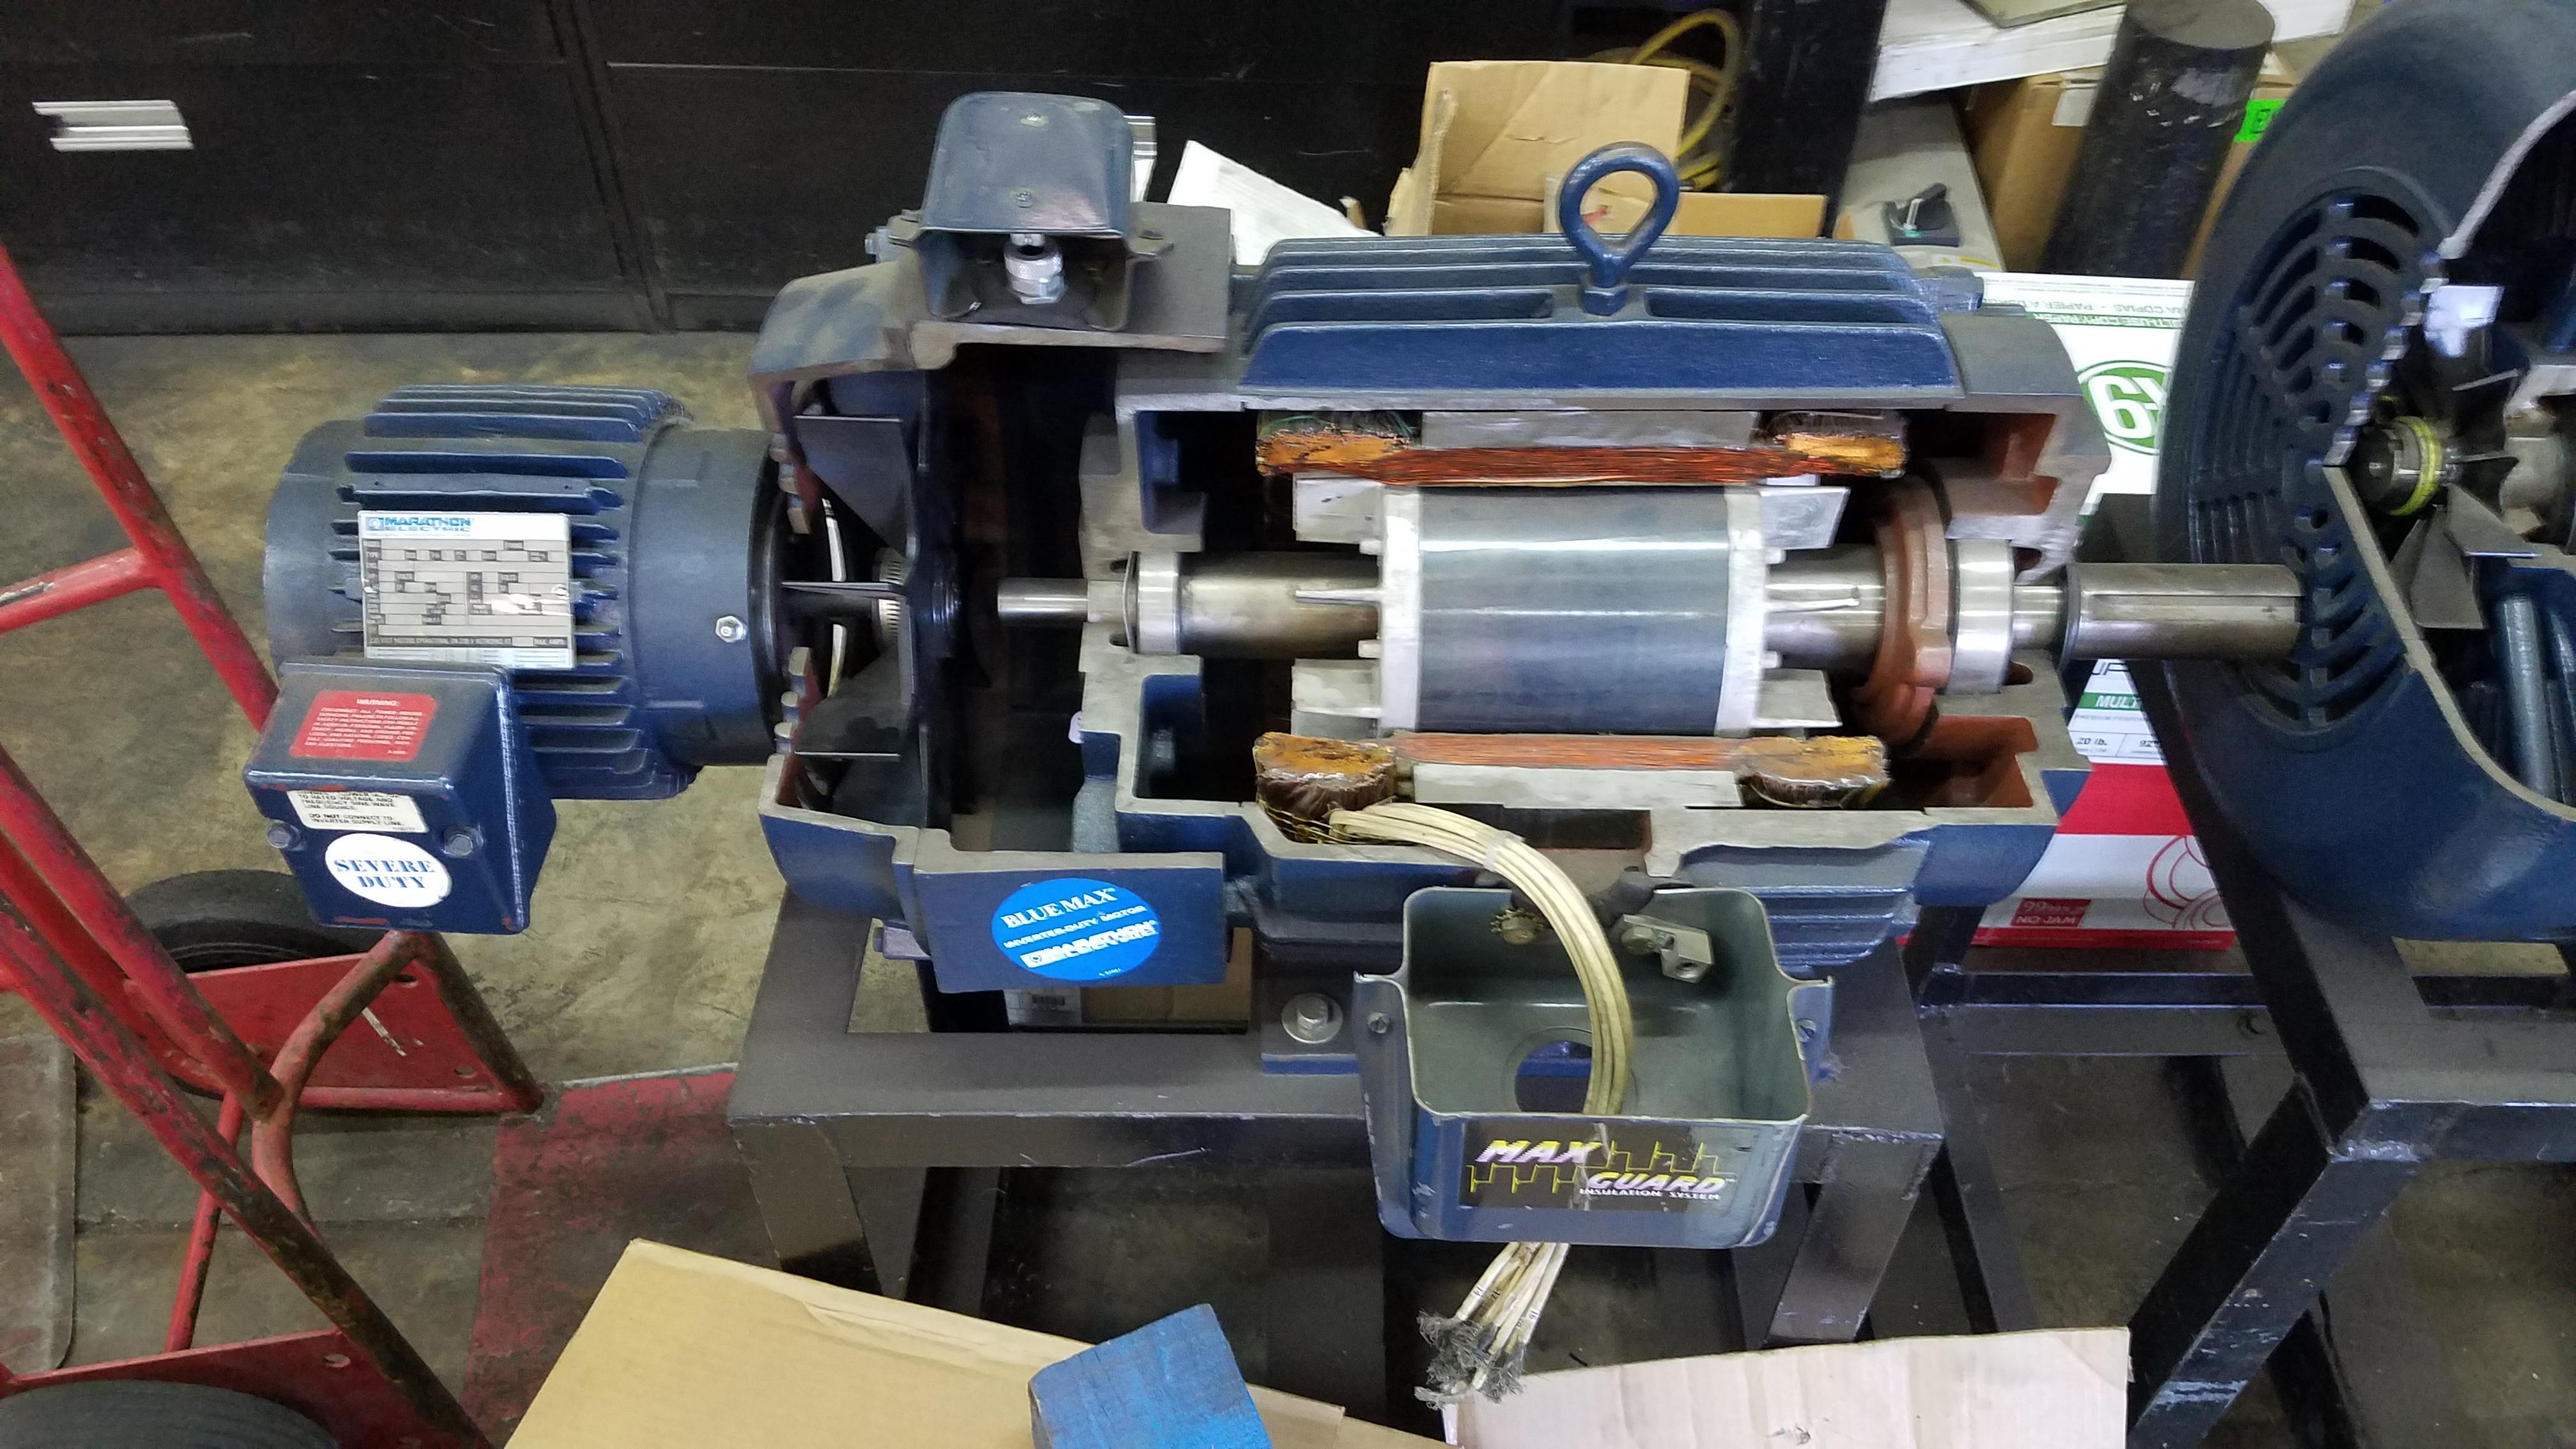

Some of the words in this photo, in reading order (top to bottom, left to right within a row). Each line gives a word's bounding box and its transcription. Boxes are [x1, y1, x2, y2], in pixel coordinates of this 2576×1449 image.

[2044, 302, 2093, 311] PAPIER
[385, 517, 471, 526] MARATHON
[2096, 695, 2140, 709] MULT
[333, 859, 435, 873] SEVERE
[358, 875, 426, 889] DUTY
[1000, 903, 1065, 928] BLUE
[1002, 917, 1099, 949] INVERTER-DUTY
[1099, 905, 1148, 923] MOTOR
[1475, 1140, 1602, 1163] MAX
[1587, 1172, 1727, 1194] GUARD
[1579, 1188, 1662, 1198] INSULATION
[1669, 1191, 1722, 1201] SYSTEM
